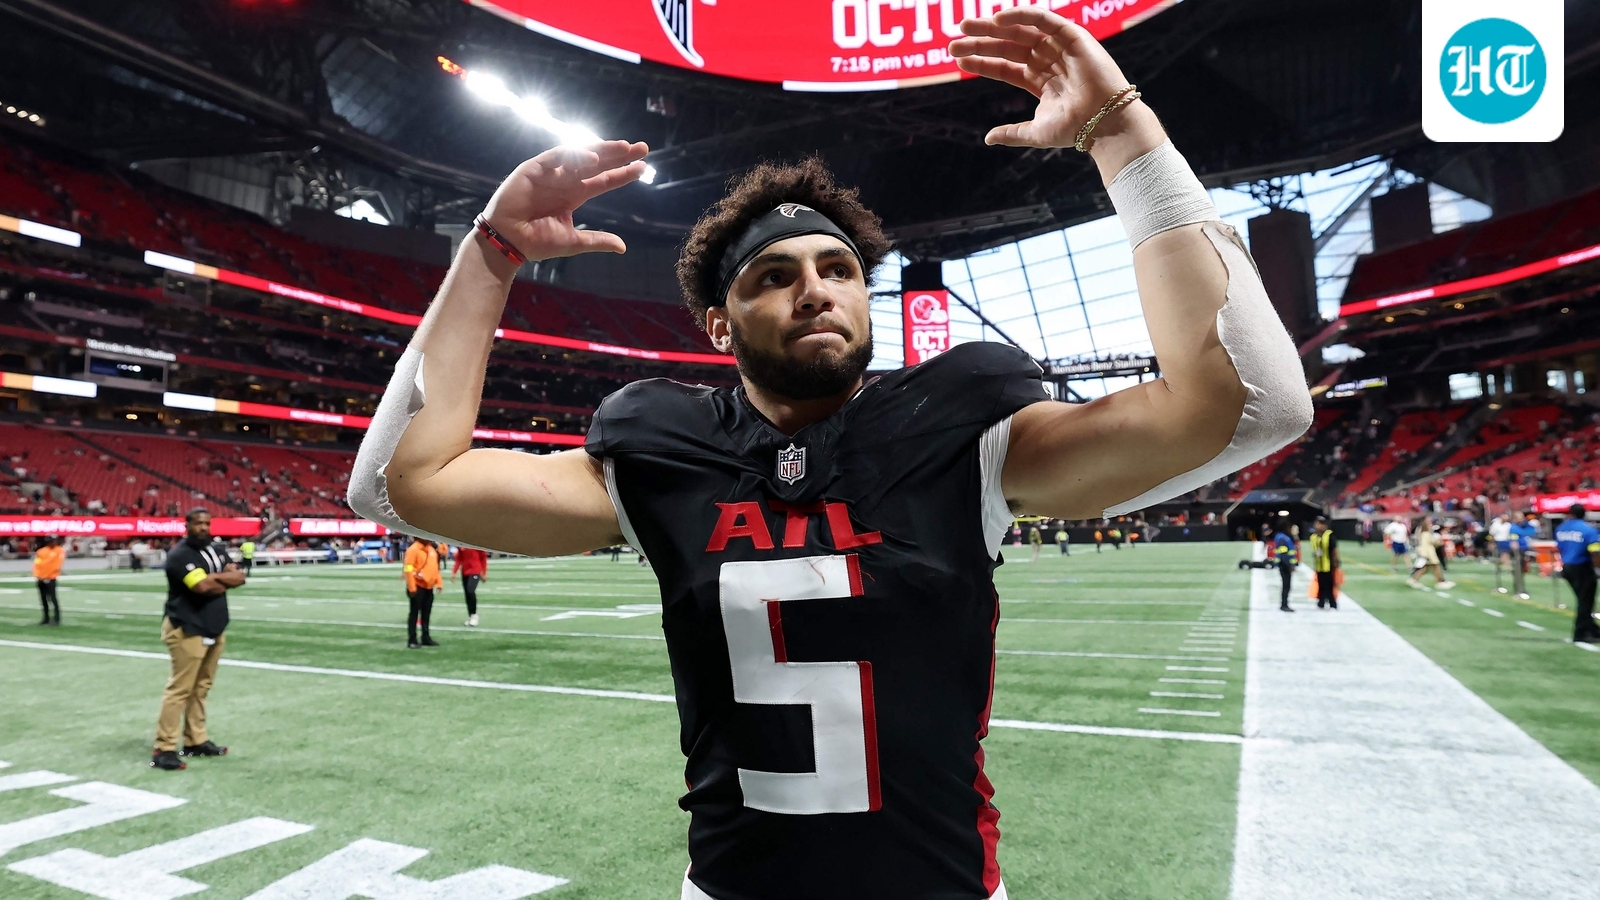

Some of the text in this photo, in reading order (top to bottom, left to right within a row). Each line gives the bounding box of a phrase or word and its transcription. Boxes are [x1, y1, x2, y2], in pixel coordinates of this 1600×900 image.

[830, 56, 870, 73] 7:15
[872, 55, 901, 74] pm
[903, 53, 925, 68] vs
[912, 330, 948, 351] OCT
[1114, 358, 1151, 370] Stadium
[781, 461, 801, 478] NFL
[13, 520, 31, 532] vs
[31, 519, 96, 533] BUFFALO
[706, 501, 882, 552] ATL
[719, 553, 882, 814] 5
